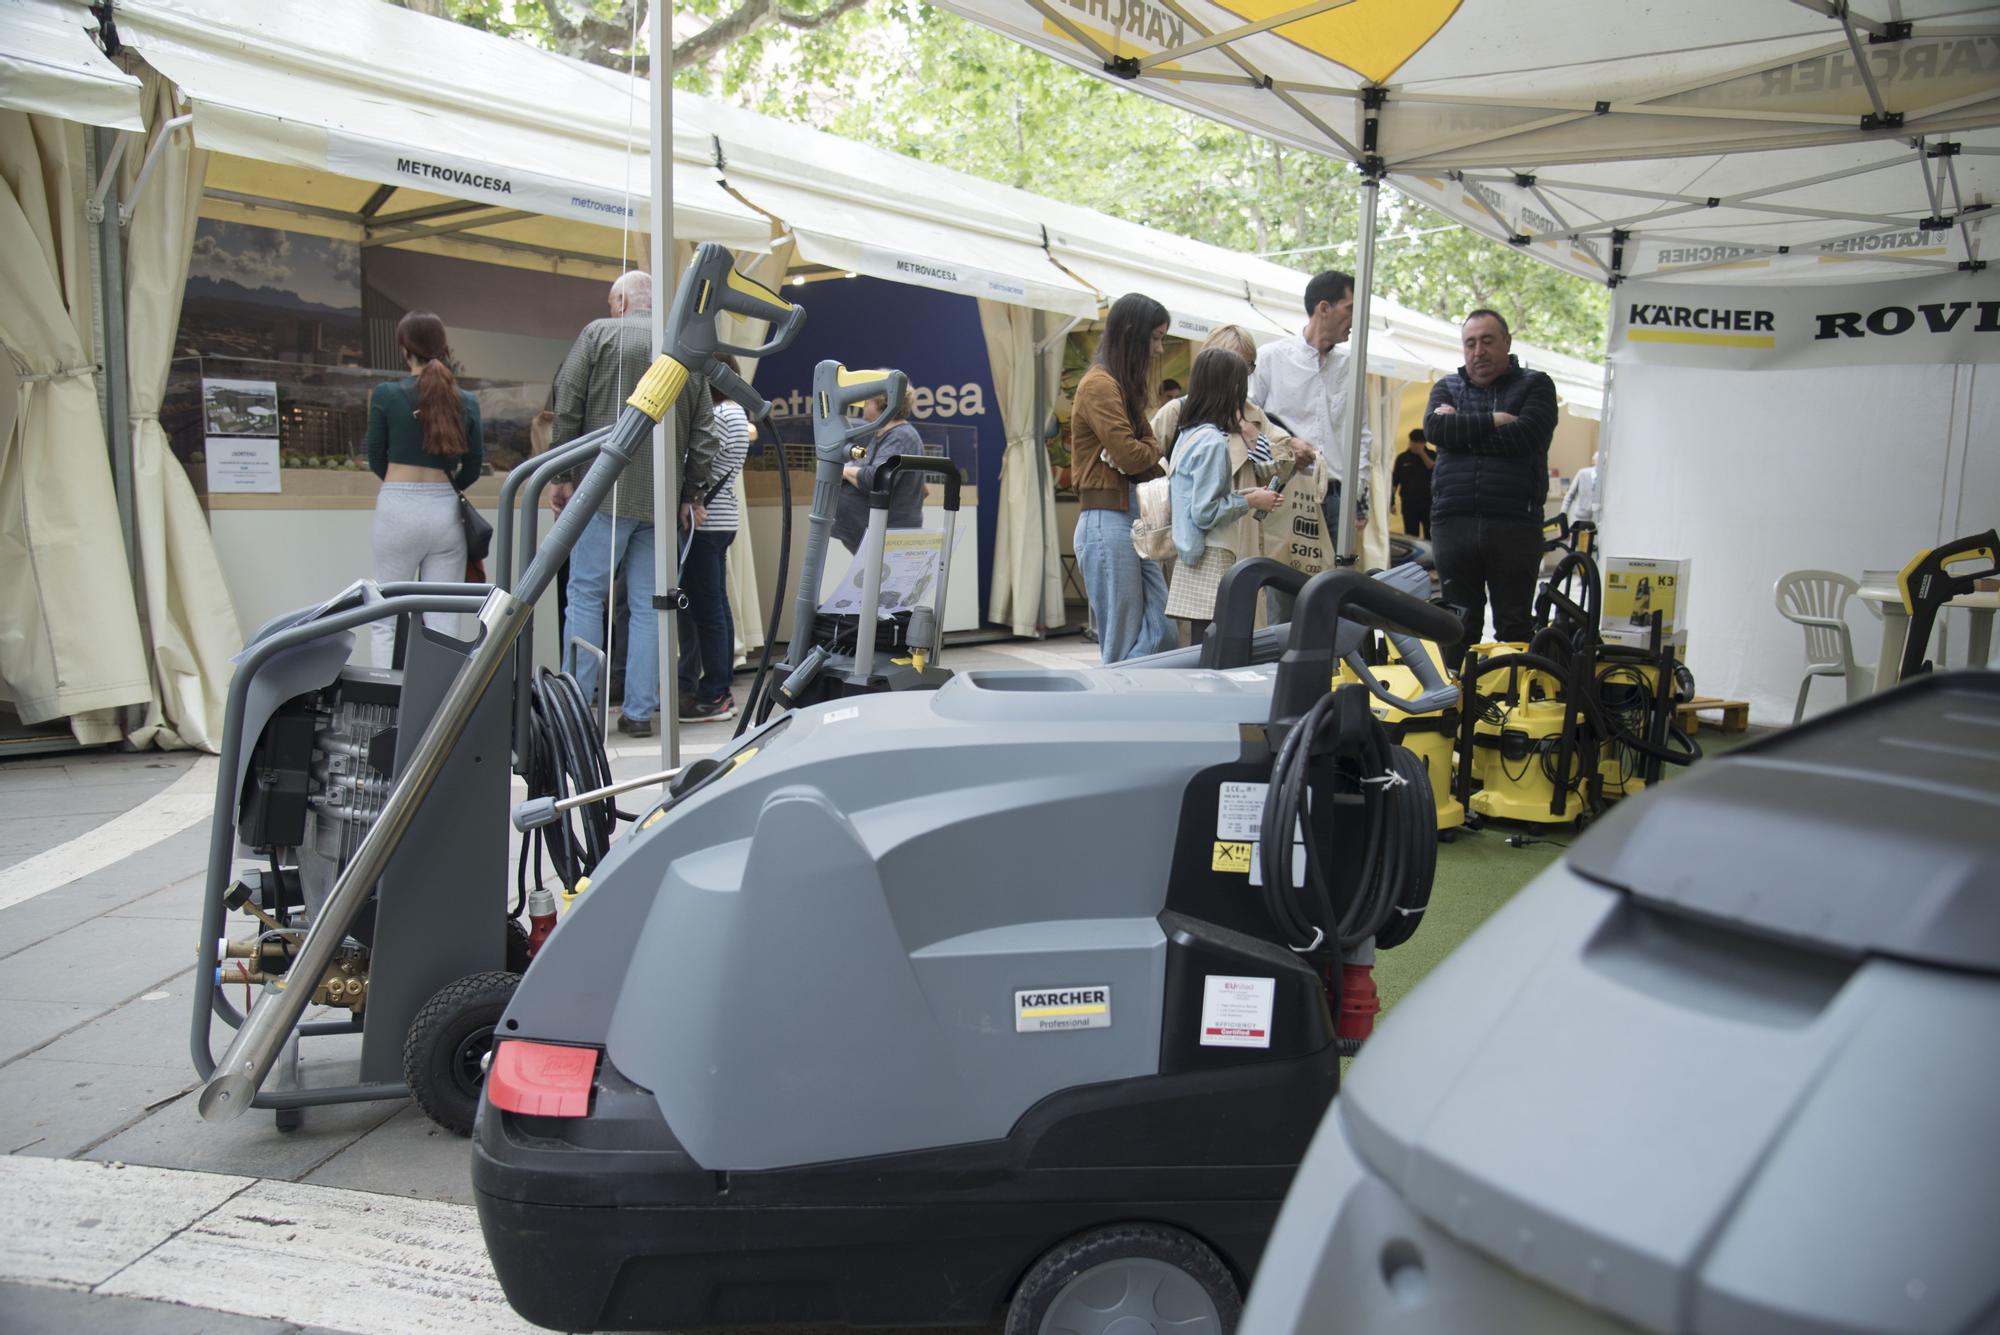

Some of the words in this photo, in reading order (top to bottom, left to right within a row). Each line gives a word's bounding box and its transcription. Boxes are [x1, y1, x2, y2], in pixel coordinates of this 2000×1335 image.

[397, 157, 512, 194] METROVACESA
[571, 195, 634, 217] metrovacesa
[896, 260, 957, 282] METROVACESA
[1628, 303, 1775, 332] KÄRCHER
[1658, 576, 1674, 587] K3
[1021, 991, 1105, 1007] KÄRCHER
[1040, 1018, 1090, 1029] Professional
